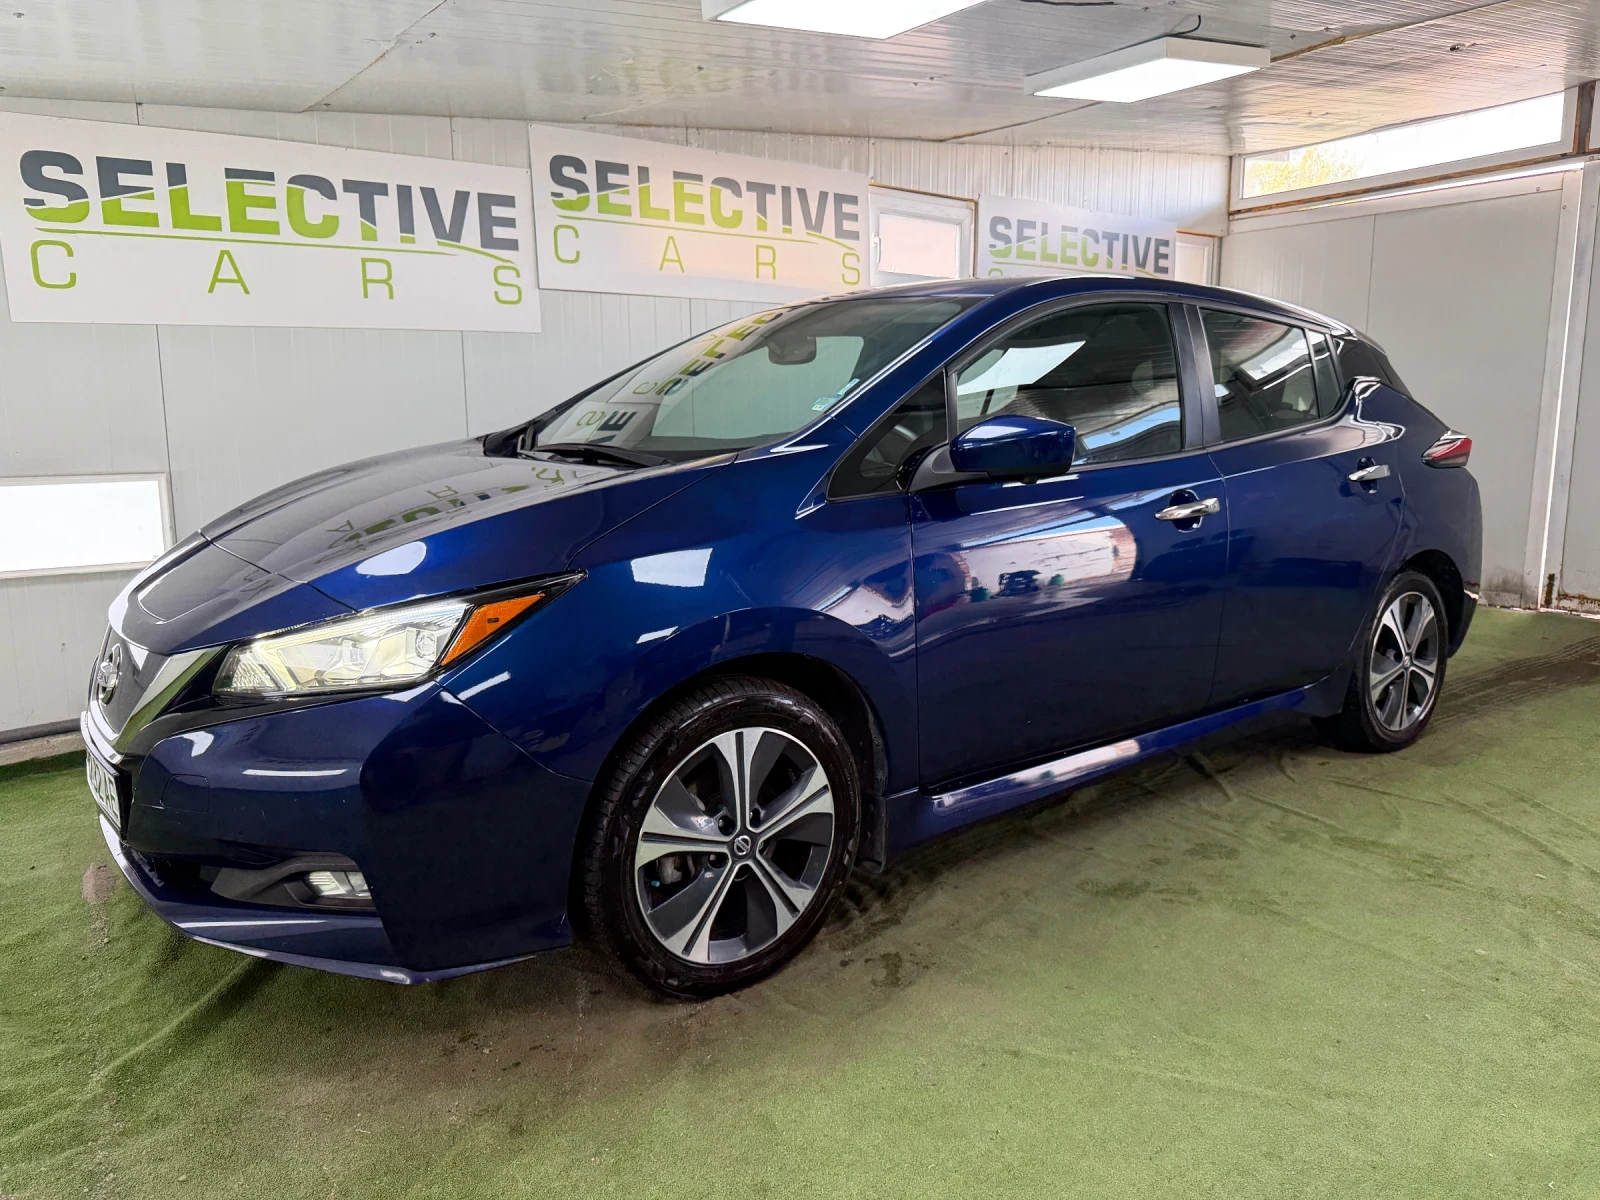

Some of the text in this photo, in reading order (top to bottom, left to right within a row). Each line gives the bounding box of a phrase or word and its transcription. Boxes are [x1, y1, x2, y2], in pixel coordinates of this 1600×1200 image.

[19, 149, 520, 252] SELECTIVE
[549, 154, 861, 241] SELECTIVE
[29, 239, 523, 306] CARS
[553, 223, 861, 286] CARS
[988, 215, 1170, 275] SELECTIVE
